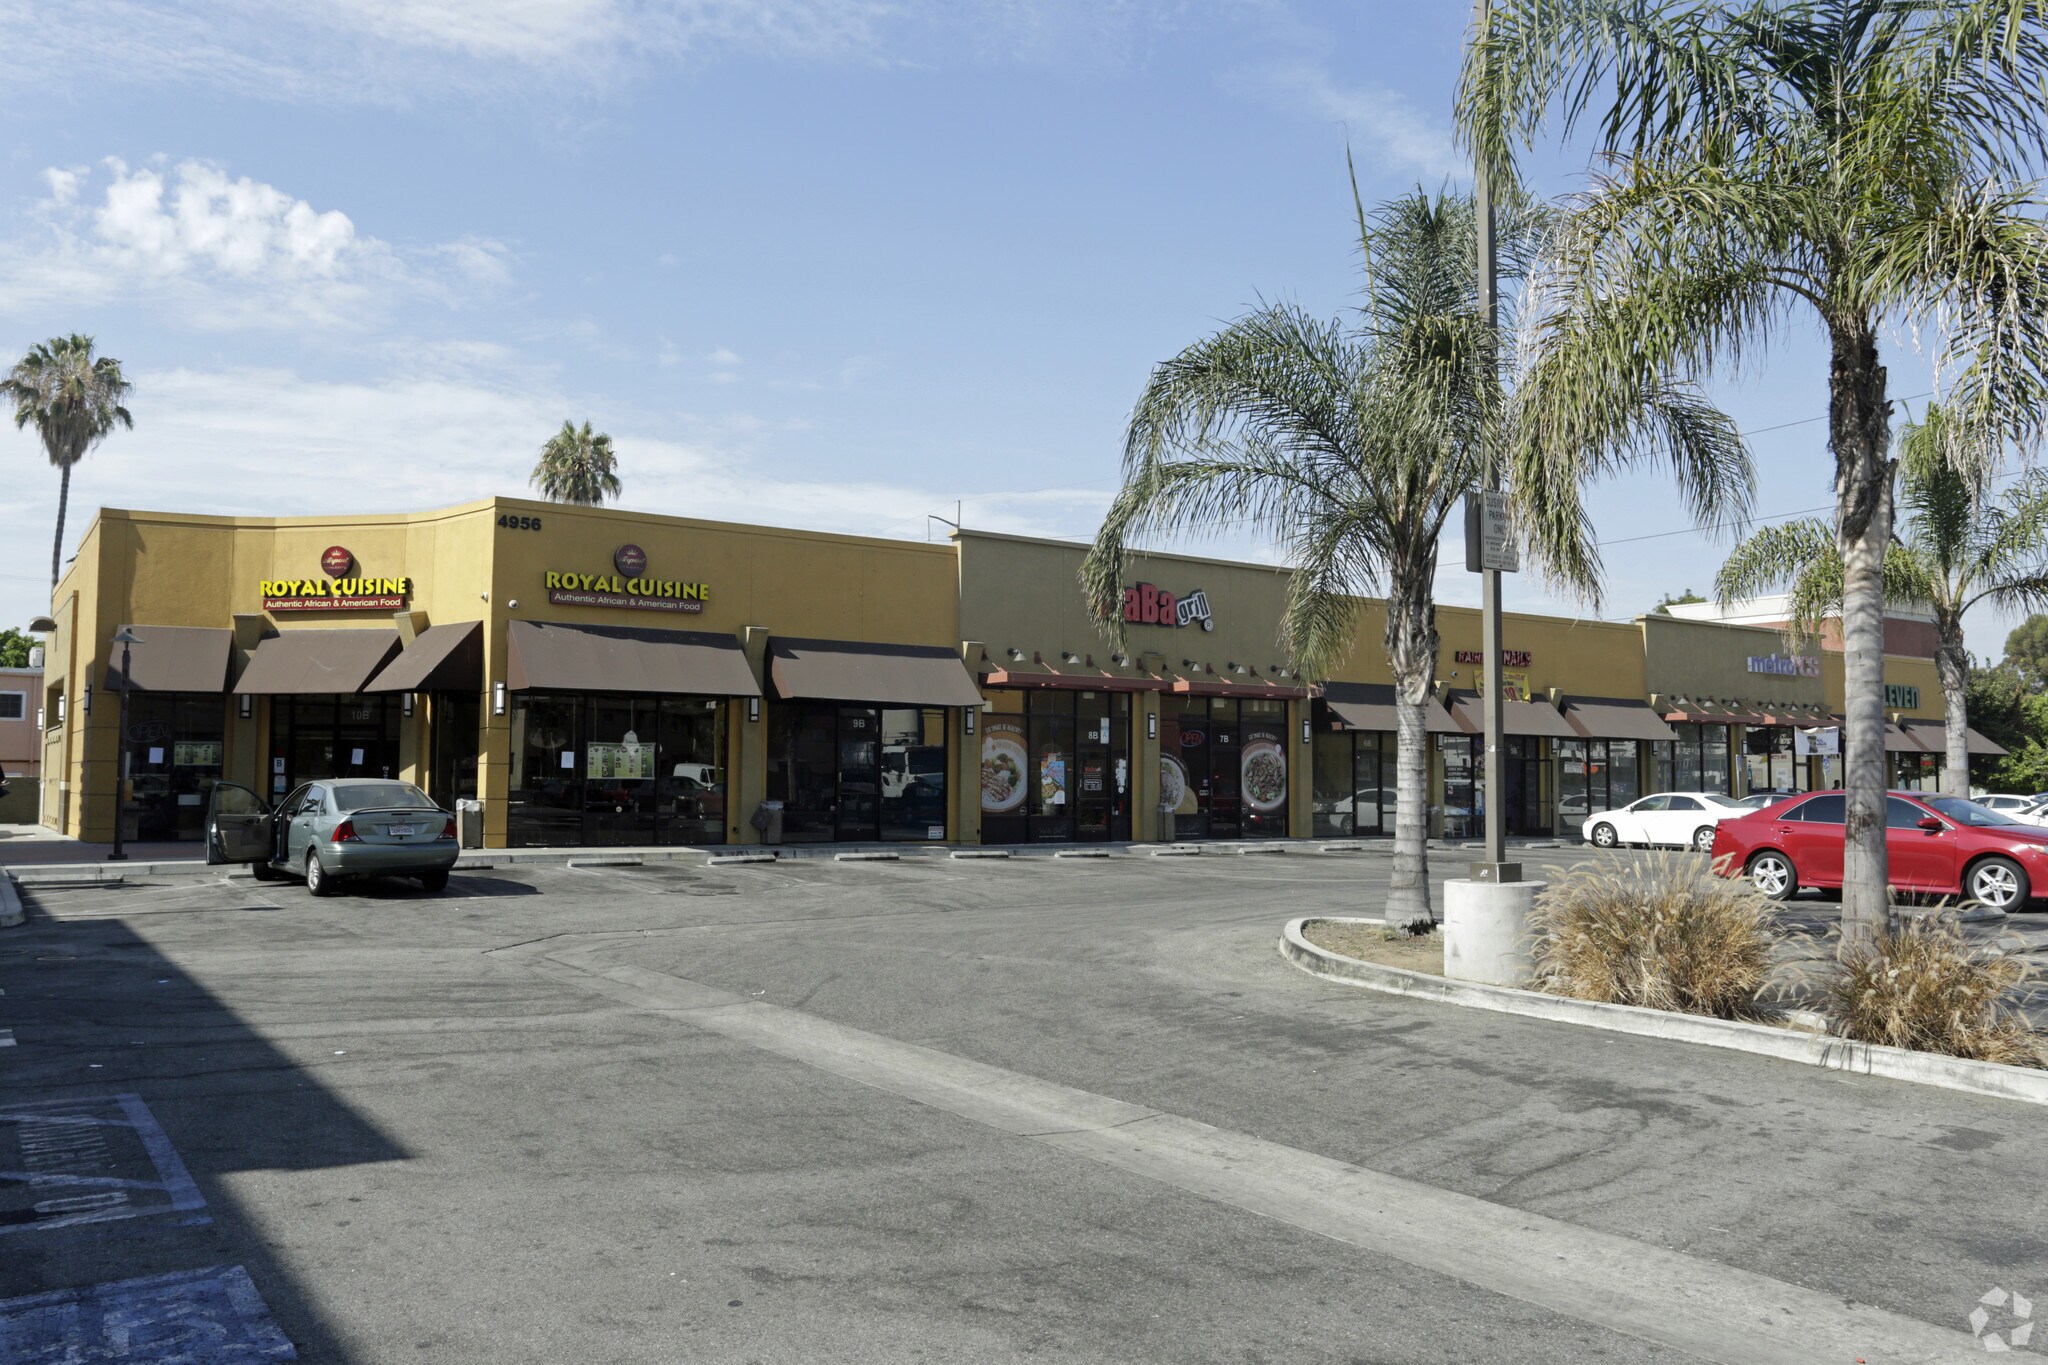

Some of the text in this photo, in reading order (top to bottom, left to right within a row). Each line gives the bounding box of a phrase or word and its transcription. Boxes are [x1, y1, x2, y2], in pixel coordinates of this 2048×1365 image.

[497, 514, 542, 531] 4956
[259, 577, 407, 597] ROYAL CUISINE
[546, 571, 709, 600] ROYAL CUISINE
[266, 600, 302, 608] Authentic
[333, 599, 339, 607] &
[341, 599, 378, 607] American
[380, 598, 401, 606] Food
[554, 592, 596, 605] Authentic
[597, 596, 627, 606] African
[638, 599, 677, 610] American
[679, 601, 700, 612] Food
[1098, 583, 1176, 625] aBa
[1177, 592, 1211, 625] grill
[351, 711, 370, 720] 10B
[853, 719, 866, 728] 9B
[1088, 731, 1099, 740] 8B
[1181, 732, 1202, 744] OPEN
[1219, 735, 1229, 743] 7B
[276, 759, 283, 767] B
